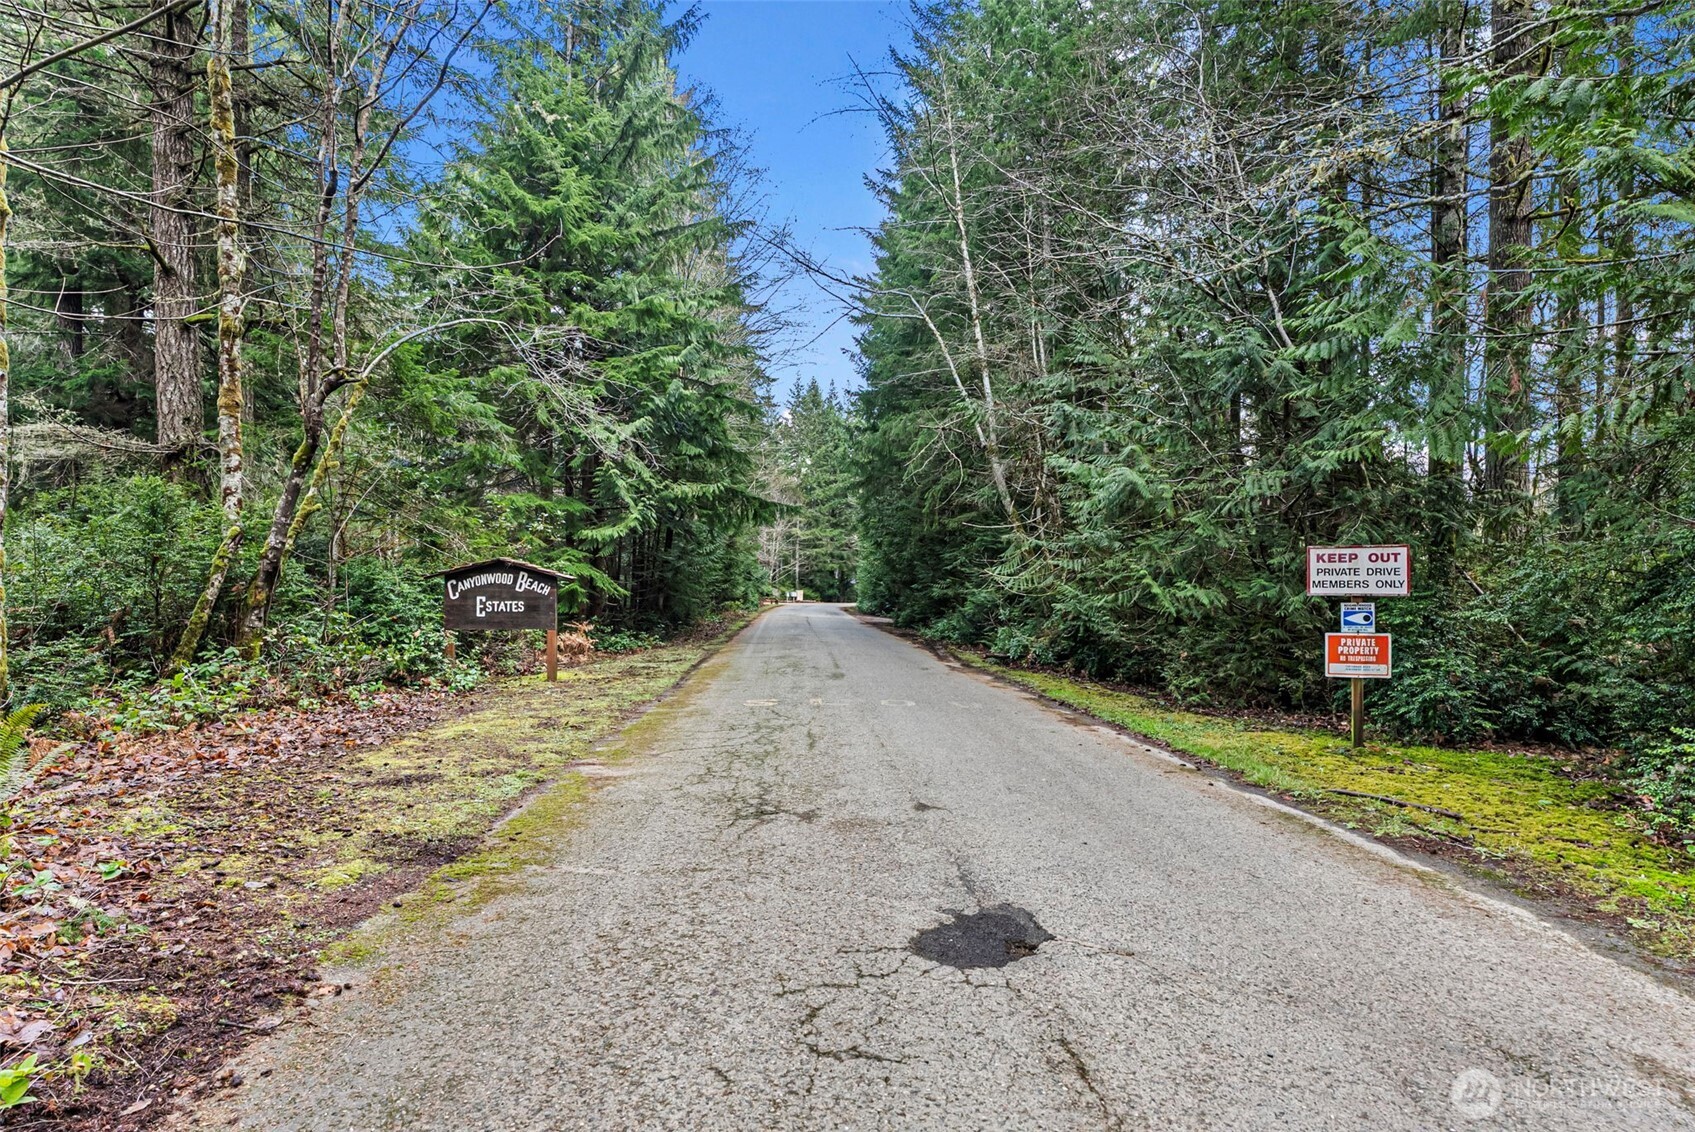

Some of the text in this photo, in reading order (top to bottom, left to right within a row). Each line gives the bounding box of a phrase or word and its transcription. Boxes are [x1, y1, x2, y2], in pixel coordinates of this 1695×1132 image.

[1316, 552, 1401, 563] KEEP OUT
[1316, 567, 1401, 576] PRIVATE DRIVE
[447, 571, 551, 599] CANYONWOOD BEACH
[1312, 580, 1405, 588] MEMBERS ONLY
[476, 596, 525, 617] ESTATES
[1340, 638, 1376, 646] PRIVATE
[1337, 646, 1380, 654] PROPERTY
